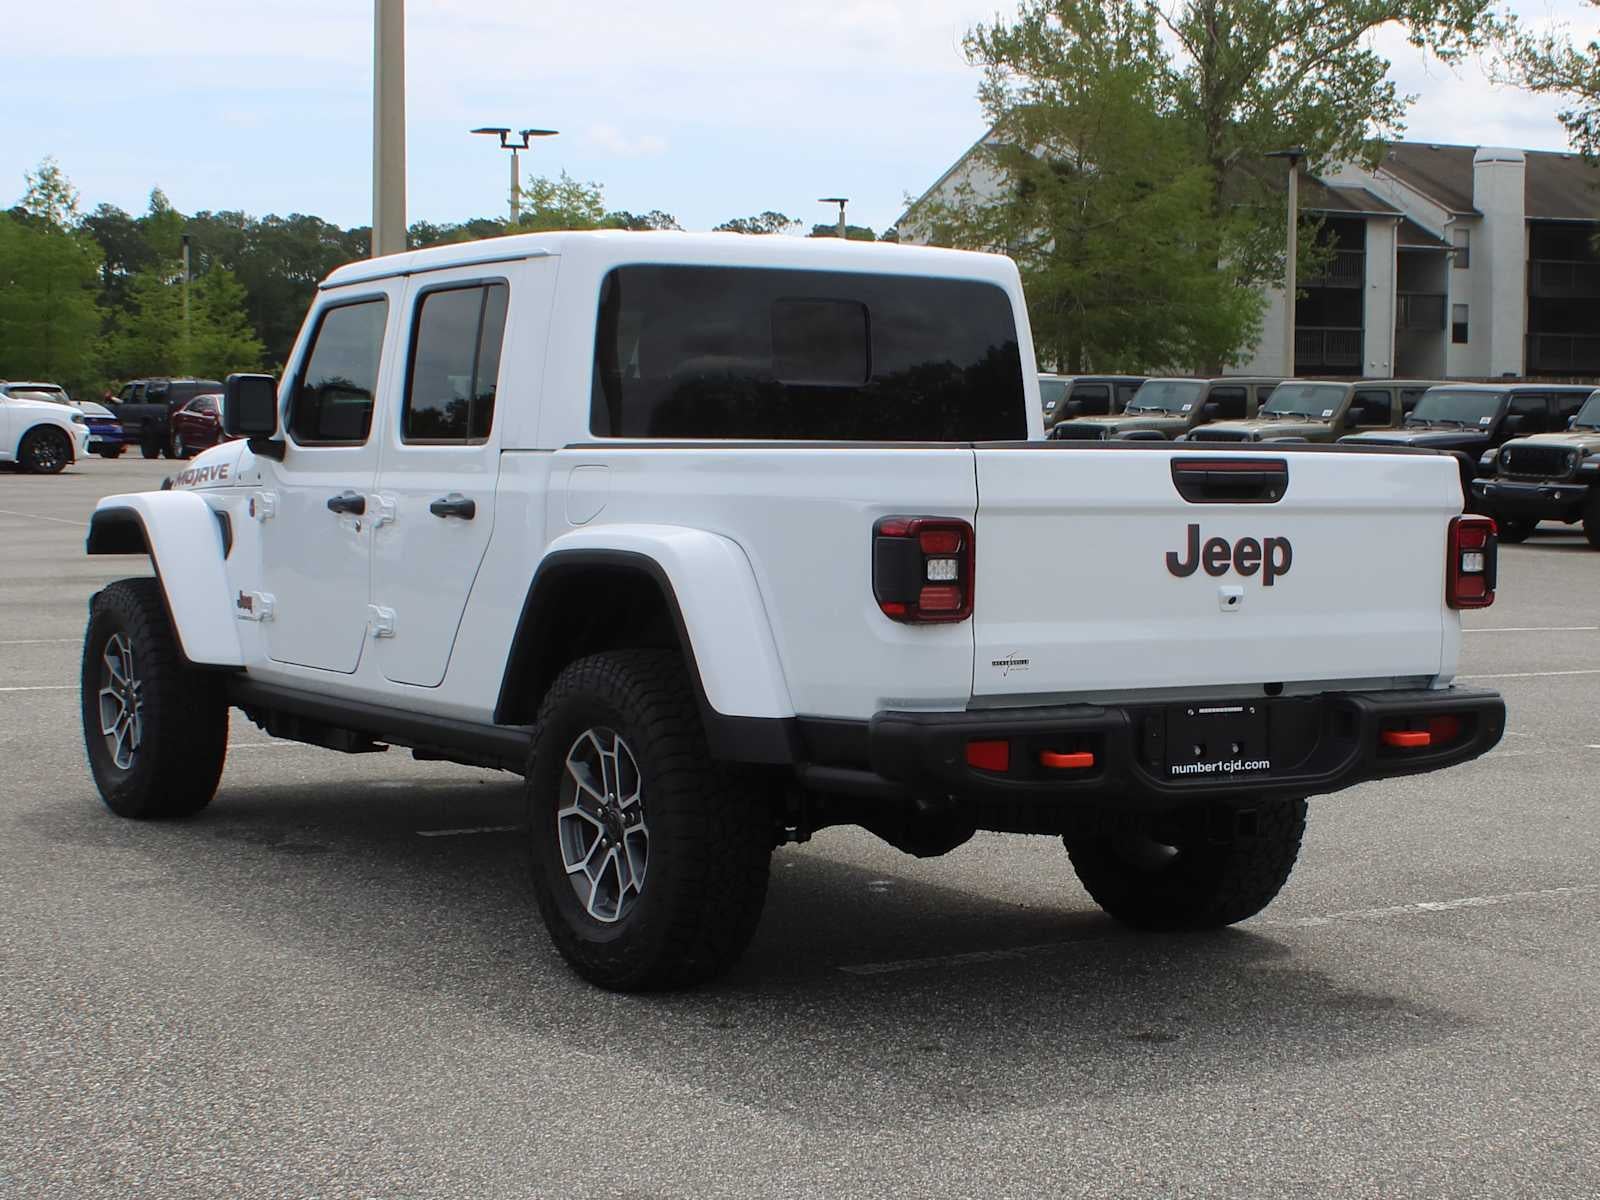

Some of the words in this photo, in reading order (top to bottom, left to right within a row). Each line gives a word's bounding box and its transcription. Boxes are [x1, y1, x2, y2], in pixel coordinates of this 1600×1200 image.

[175, 463, 230, 487] MOJAVE
[1166, 523, 1293, 587] Jeep
[1171, 760, 1270, 774] number1cjd.com
